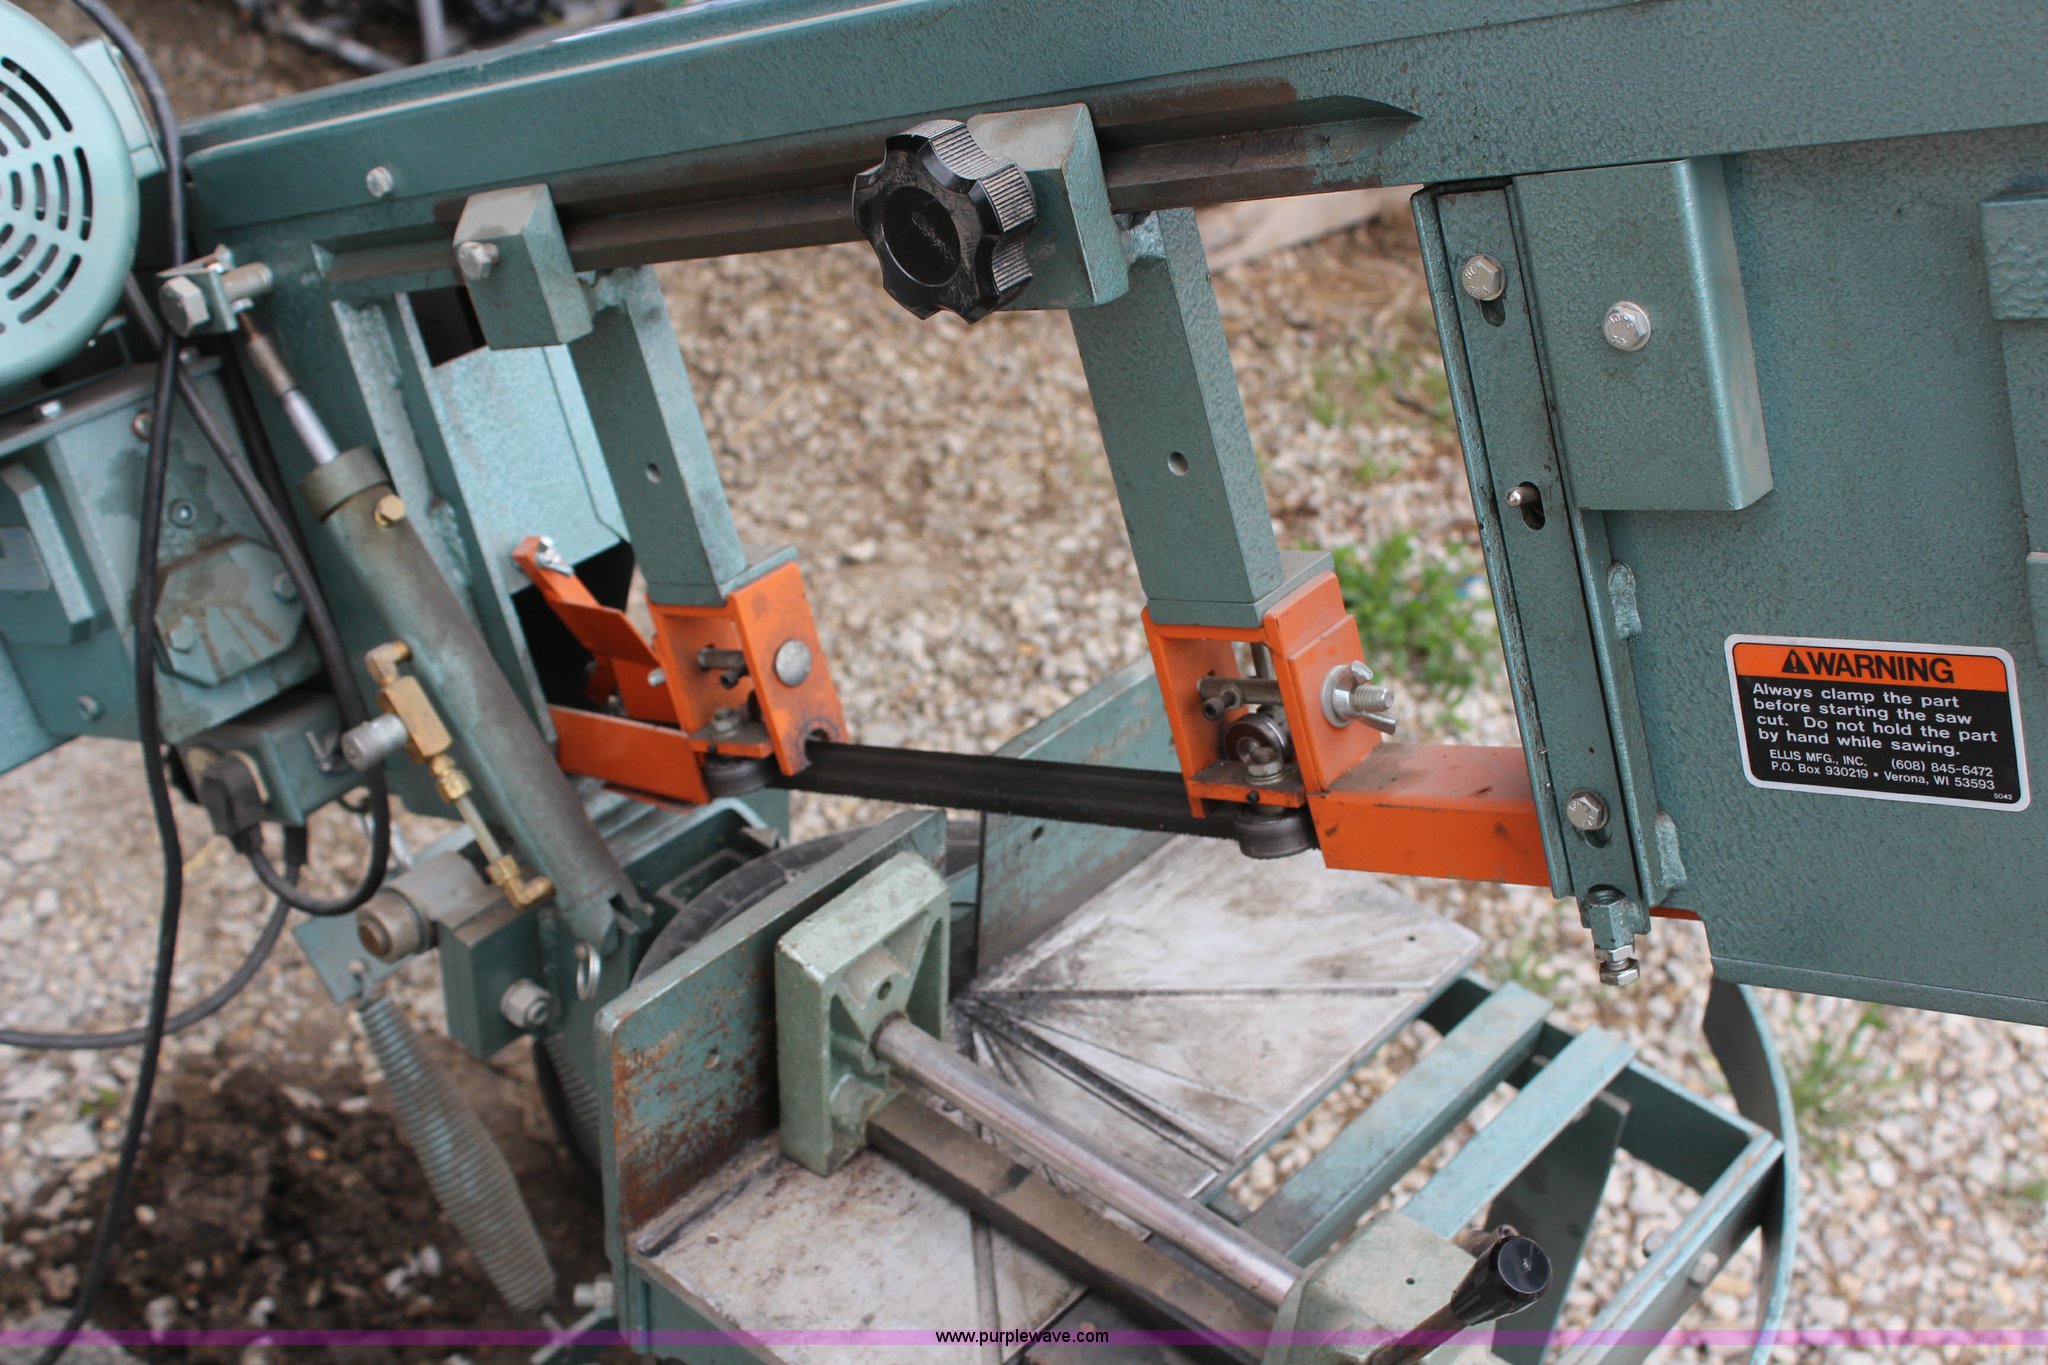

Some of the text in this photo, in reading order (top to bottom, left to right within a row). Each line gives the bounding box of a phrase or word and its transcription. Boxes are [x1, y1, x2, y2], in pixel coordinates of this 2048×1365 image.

[1807, 652, 1955, 684] WARNING
[1753, 683, 1960, 708] Always clamp the part
[1753, 698, 1972, 725] before starting the saw
[1756, 715, 1998, 742] cut. Do not hold the part
[1758, 728, 1960, 757] by hand while sawing.
[1769, 749, 1994, 777] ELLIS MFG., INC. (608) 845-6472
[1771, 761, 1995, 790] P.O. Box 930219 Verona, WI 53593
[1993, 793, 2013, 801] 5042
